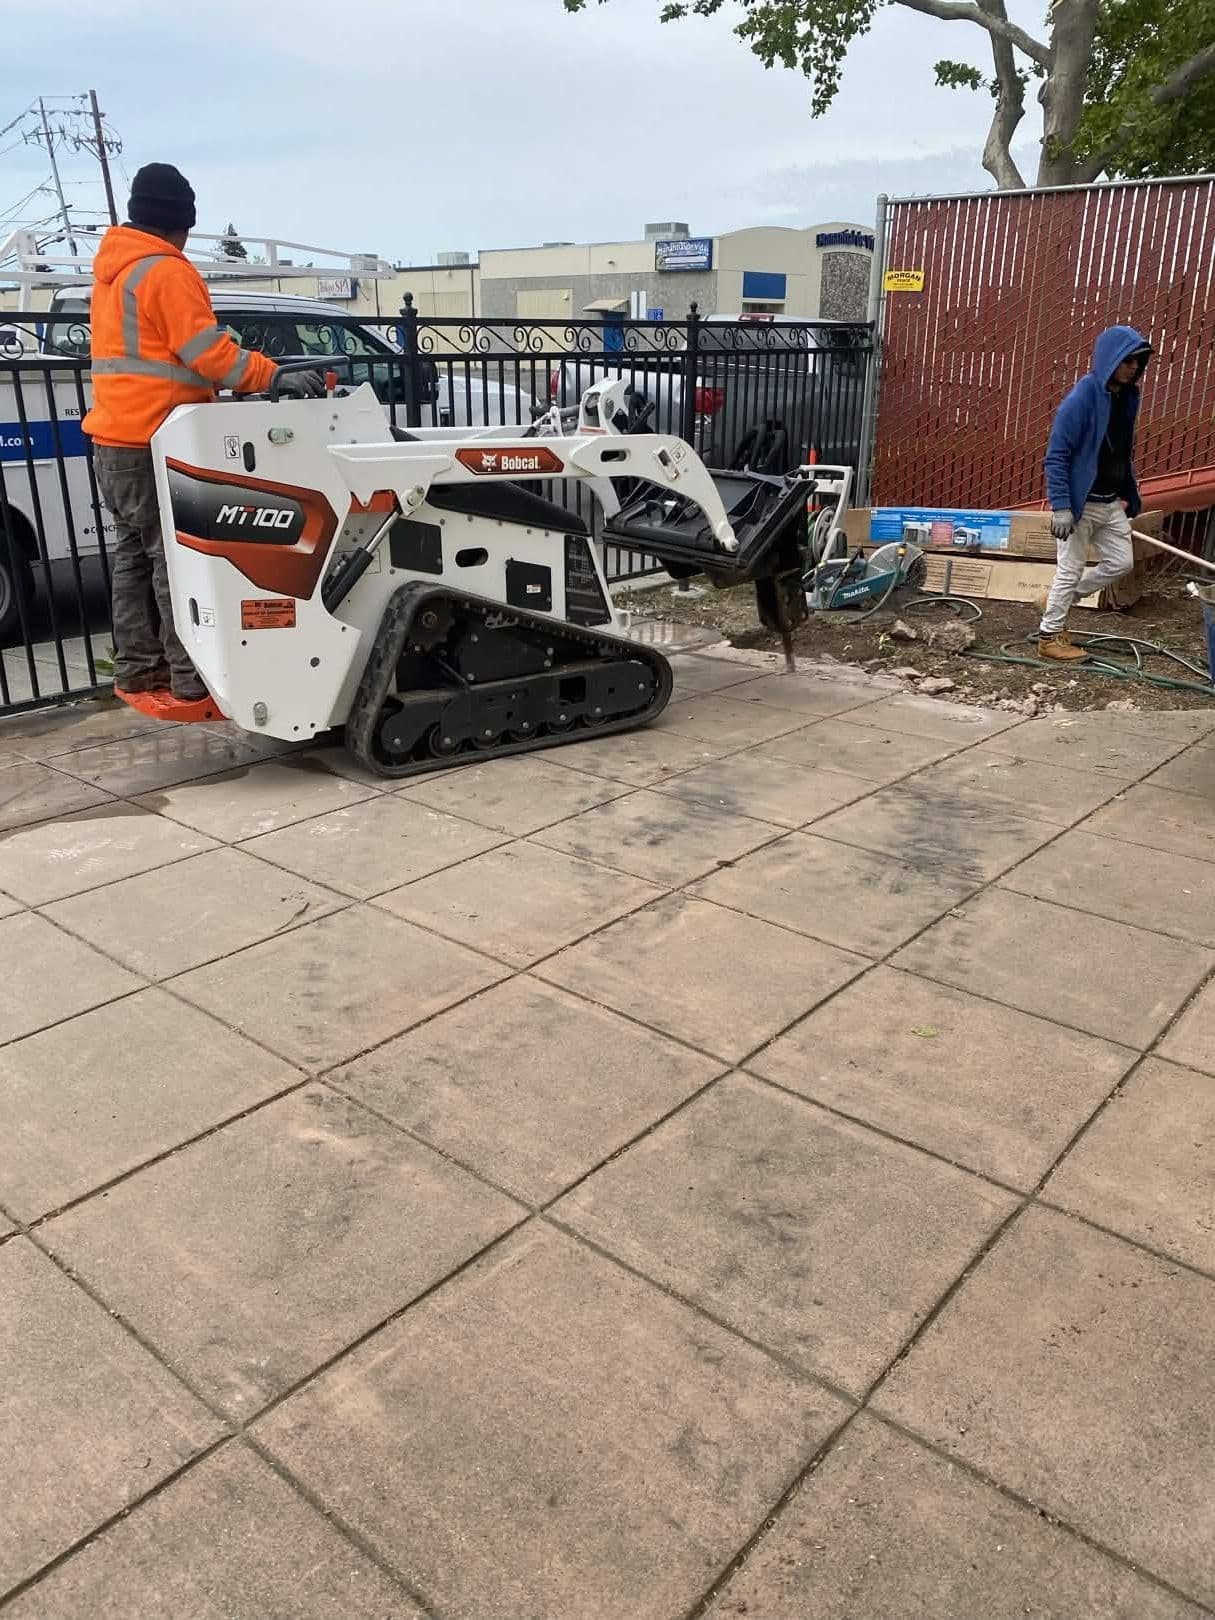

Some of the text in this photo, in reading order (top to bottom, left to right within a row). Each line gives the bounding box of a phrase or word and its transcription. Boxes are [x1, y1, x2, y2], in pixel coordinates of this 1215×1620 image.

[887, 272, 921, 282] MORGAN
[501, 455, 539, 471] Bobcat
[216, 504, 295, 529] MT100
